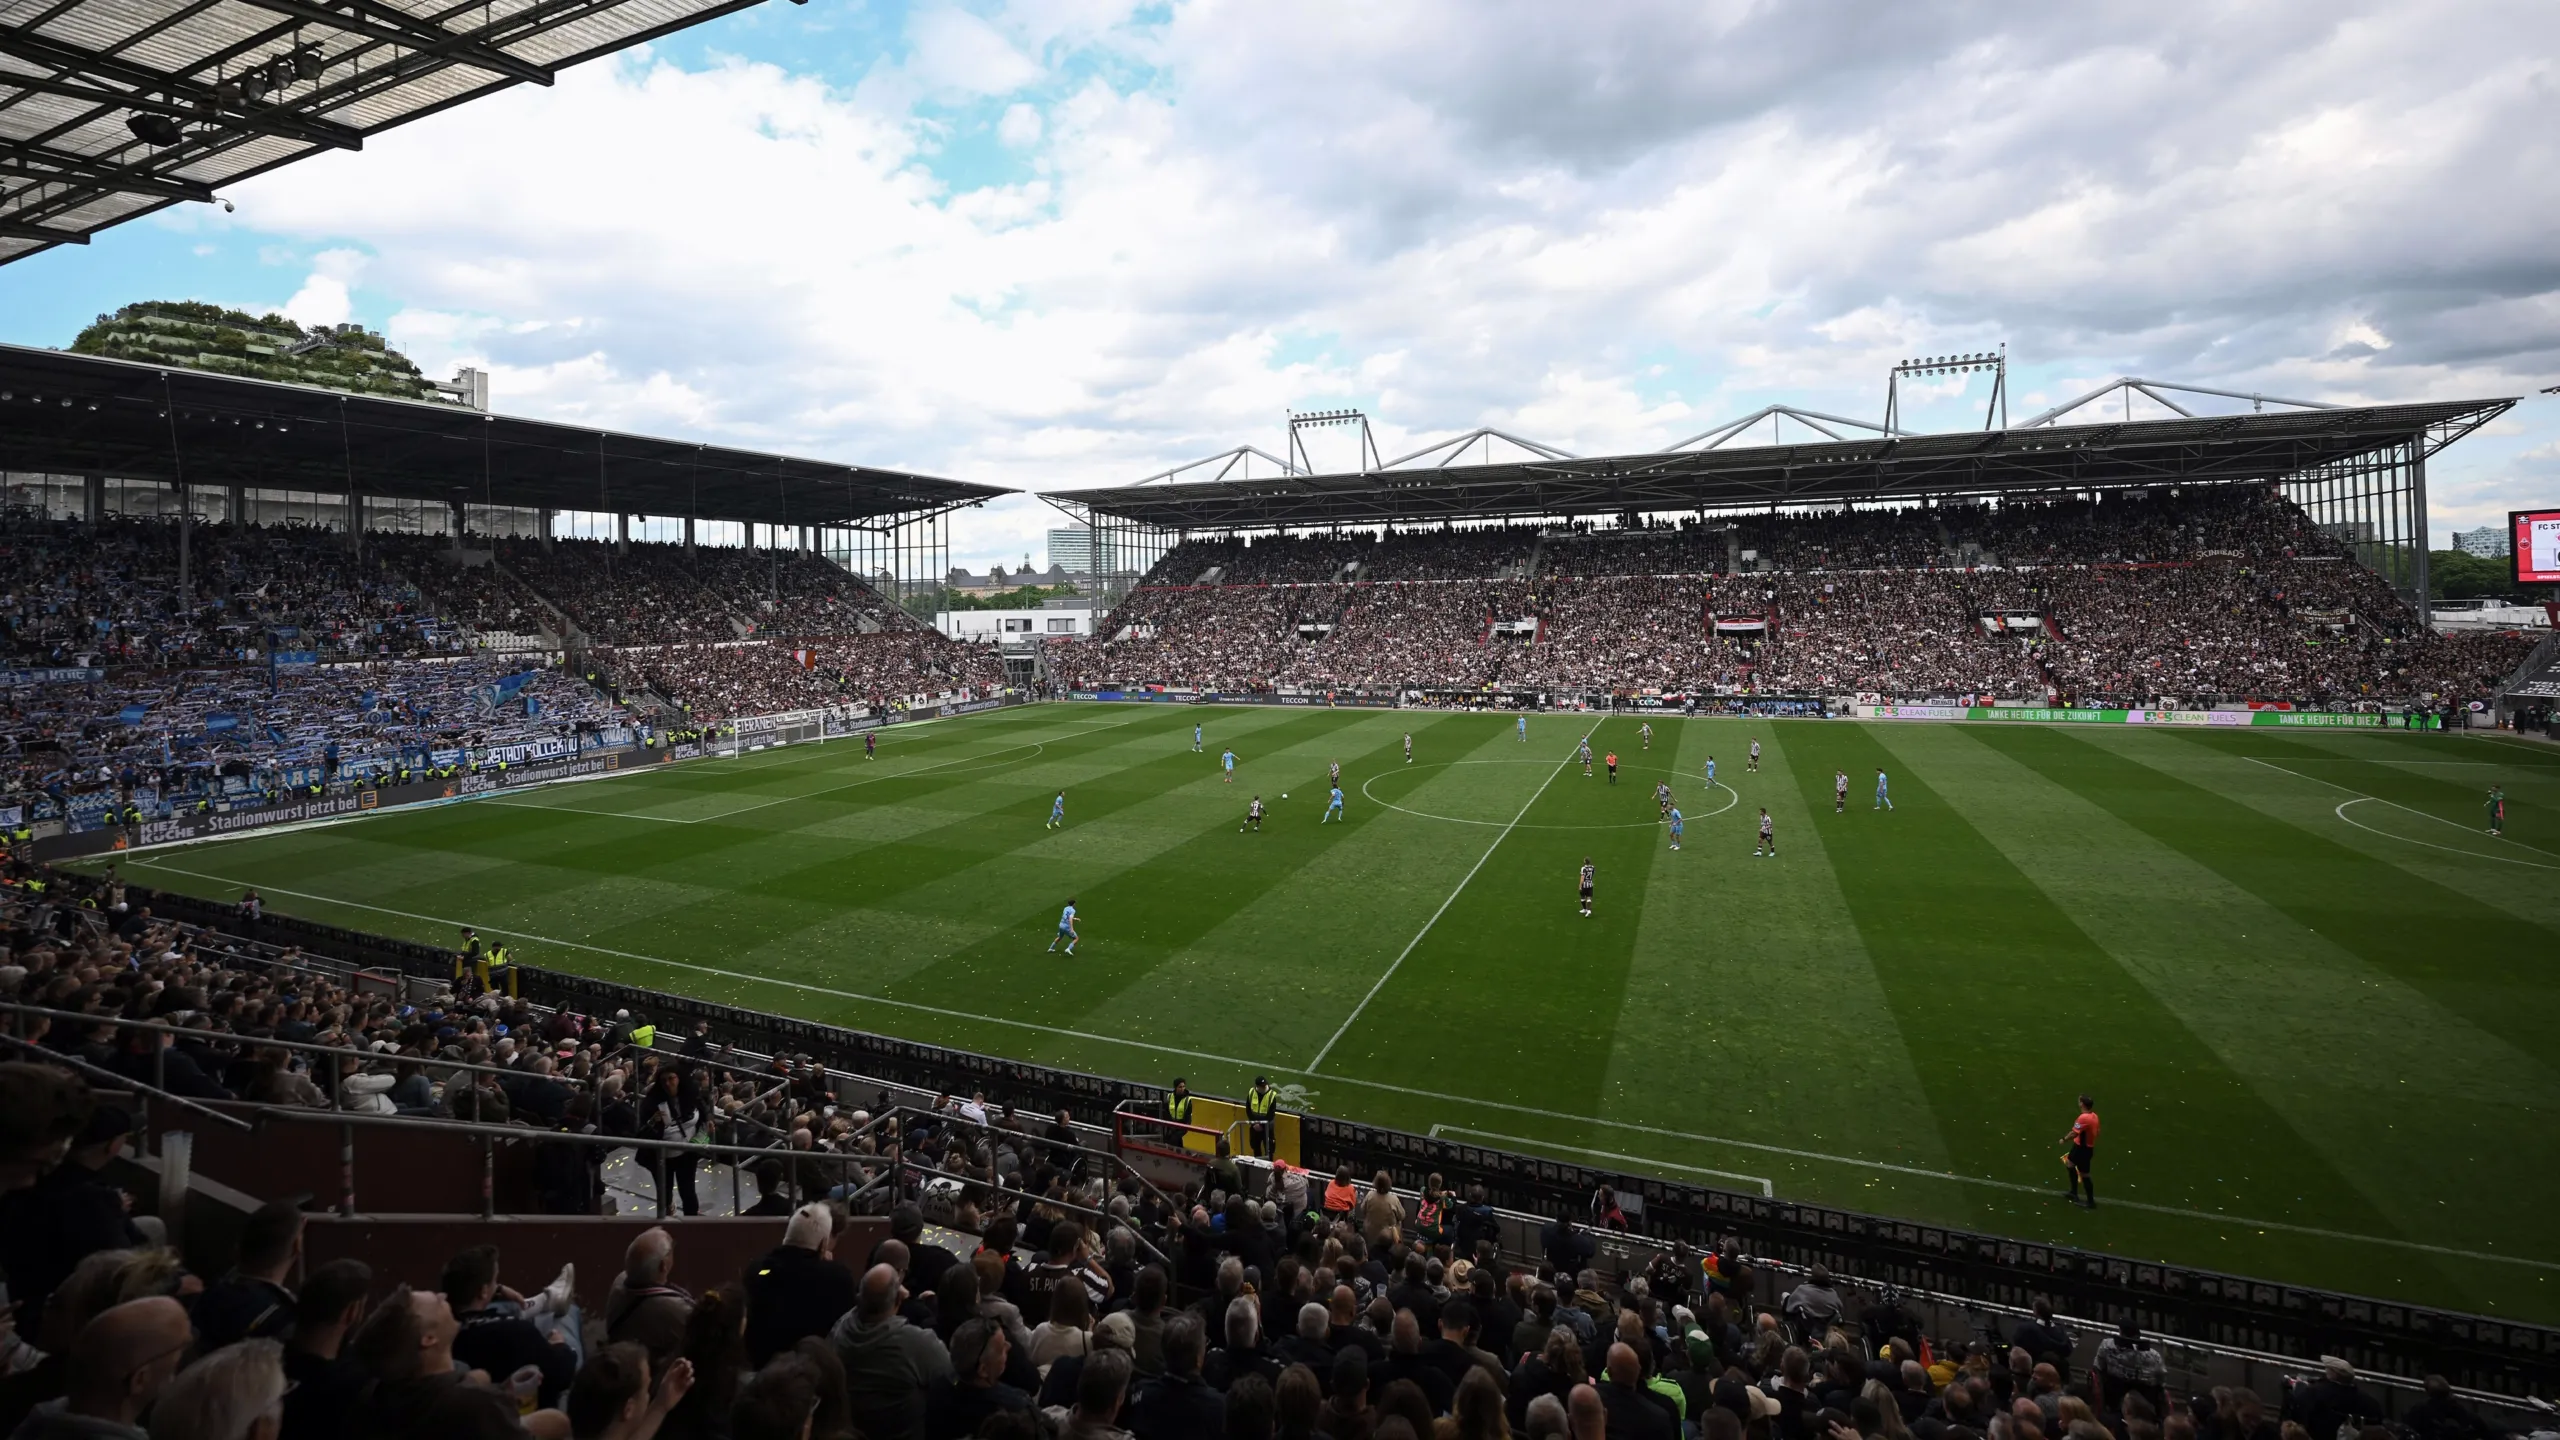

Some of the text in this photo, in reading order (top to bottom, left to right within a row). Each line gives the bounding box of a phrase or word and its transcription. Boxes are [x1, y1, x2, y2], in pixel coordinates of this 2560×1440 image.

[1900, 708, 1926, 716] CLEAN
[1986, 709, 2101, 720] TANKE HEUTE FÜR DIE ZUKUNFT
[2207, 714, 2236, 722] FUELS
[2279, 714, 2305, 724] TANKE
[2308, 715, 2335, 725] HEUTE
[2337, 714, 2354, 725] FÜR
[2356, 716, 2371, 725] DIE
[737, 716, 776, 733] ETERANEN
[750, 735, 766, 747] jetzt
[767, 732, 776, 742] bei
[675, 744, 700, 759] KIEZ KÜCHE
[505, 764, 567, 784] Stadionwurst
[569, 761, 590, 776] jetzt
[591, 759, 604, 770] bei
[461, 774, 496, 794] KIEZ KÜCHE
[208, 804, 303, 832] Stadionwurst
[305, 799, 336, 819] jetzt
[338, 796, 357, 810] bei
[140, 820, 180, 836] KIEZ
[140, 827, 194, 844] KÜCHE
[1030, 1277, 1060, 1292] ST. PAU
